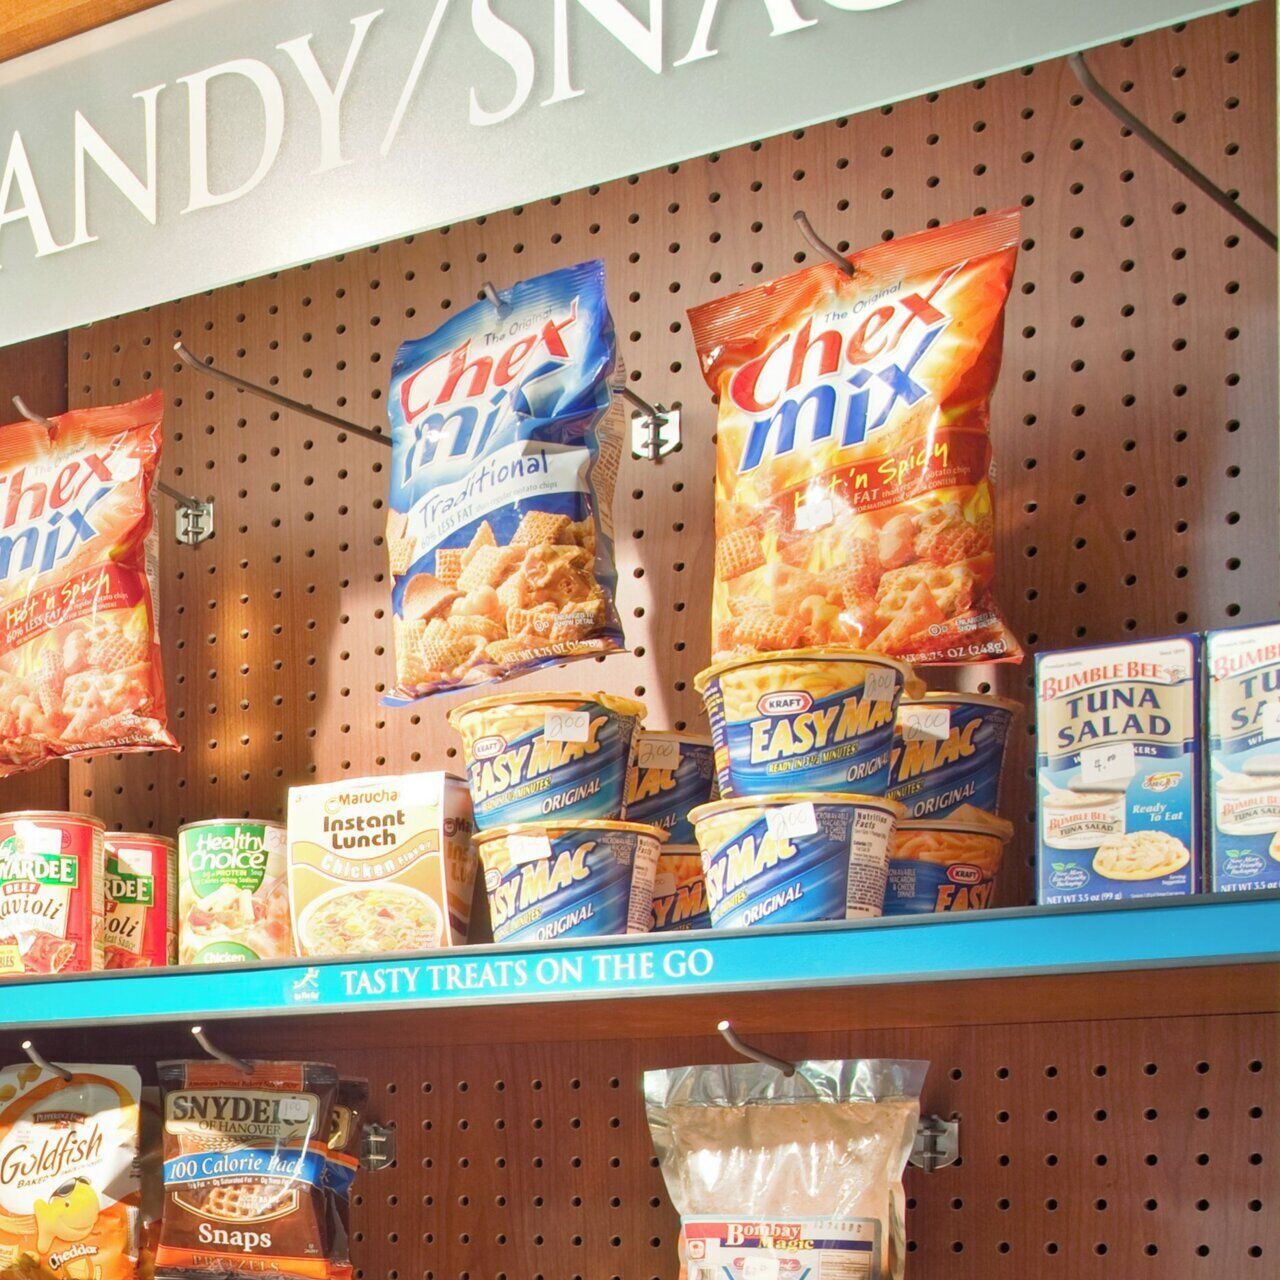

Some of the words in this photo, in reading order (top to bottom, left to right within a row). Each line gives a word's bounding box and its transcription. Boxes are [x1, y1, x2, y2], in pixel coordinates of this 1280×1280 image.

[824, 308, 848, 324] The
[852, 281, 903, 316] Original
[483, 330, 506, 346] The
[508, 306, 553, 336] Original
[729, 260, 969, 413] Chex
[400, 296, 578, 424] Chex
[738, 325, 948, 474] mix
[878, 441, 949, 484] Spicy
[420, 449, 548, 529] Traditional
[6, 598, 39, 630] Hot
[61, 566, 111, 604] Spicy
[1040, 665, 1123, 702] BUMBLE
[1127, 661, 1164, 681] BEE
[767, 698, 802, 710] KRAFT
[1066, 687, 1161, 720] TUNA
[750, 706, 840, 764] EASY
[899, 715, 983, 782] MAC
[1058, 713, 1172, 750] SALAD
[472, 751, 524, 801] EASY
[526, 715, 609, 778] MAC
[767, 759, 793, 774] READY
[822, 743, 859, 764] MINUTES!
[542, 778, 601, 814] ORIGINAL
[913, 782, 976, 818] ORIGINAL
[1132, 802, 1167, 820] Ready
[323, 809, 406, 833] Instant
[855, 820, 876, 830] Facts
[1149, 812, 1163, 823] To
[1165, 810, 1183, 822] Eat
[197, 827, 266, 853] Healthy
[332, 830, 397, 850] Lunch
[188, 850, 267, 871] Choice
[320, 855, 396, 879] Chicken
[517, 841, 597, 908] MAC
[955, 869, 977, 880] KRAFT
[4, 883, 37, 895] BEEF
[740, 883, 804, 928] ORIGINAL
[537, 902, 595, 941] ORIGINAL
[203, 951, 246, 962] Chicken
[341, 967, 419, 996] TASTY
[425, 959, 528, 990] TREATS
[534, 956, 584, 985] ON
[592, 953, 654, 981] THE
[663, 948, 714, 978] GO
[198, 1119, 216, 1131] OF
[218, 1121, 281, 1136] HANOVER
[0, 1123, 104, 1186] Goldfish
[170, 1161, 198, 1180] 100
[202, 1154, 261, 1177] Calorie
[267, 1155, 306, 1175] Pack
[198, 1223, 273, 1252] Snaps
[725, 1222, 802, 1246] Bombay
[757, 1238, 815, 1252] Magic
[48, 1243, 99, 1270] Cheddar
